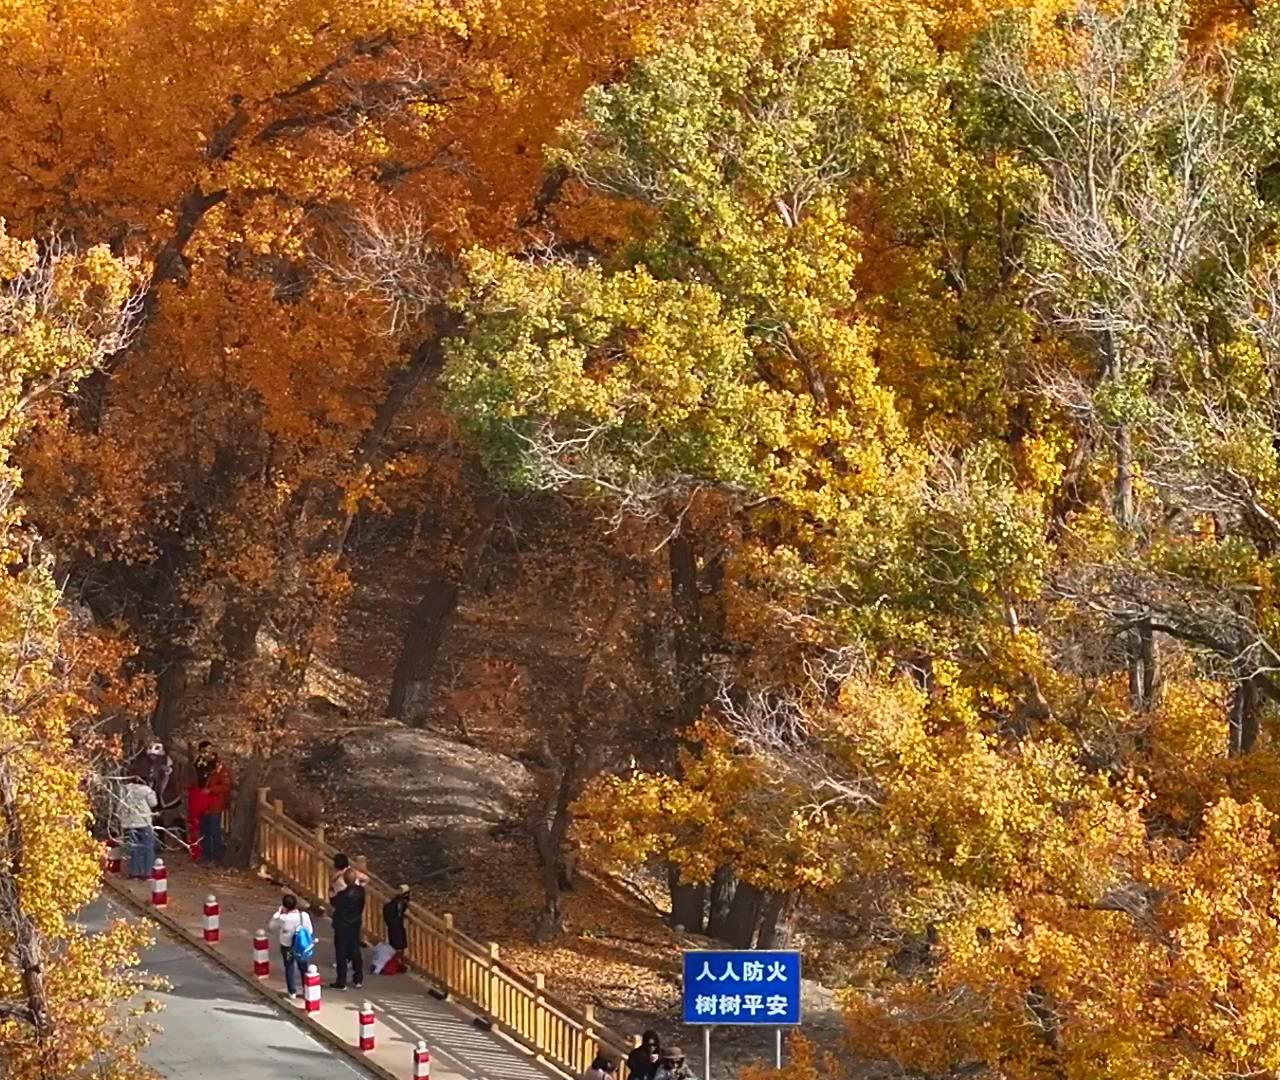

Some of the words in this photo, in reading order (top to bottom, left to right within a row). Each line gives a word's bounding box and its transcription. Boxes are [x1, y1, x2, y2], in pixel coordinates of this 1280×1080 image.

[696, 961, 788, 982] 人人防火
[695, 994, 788, 1016] 树树平安
